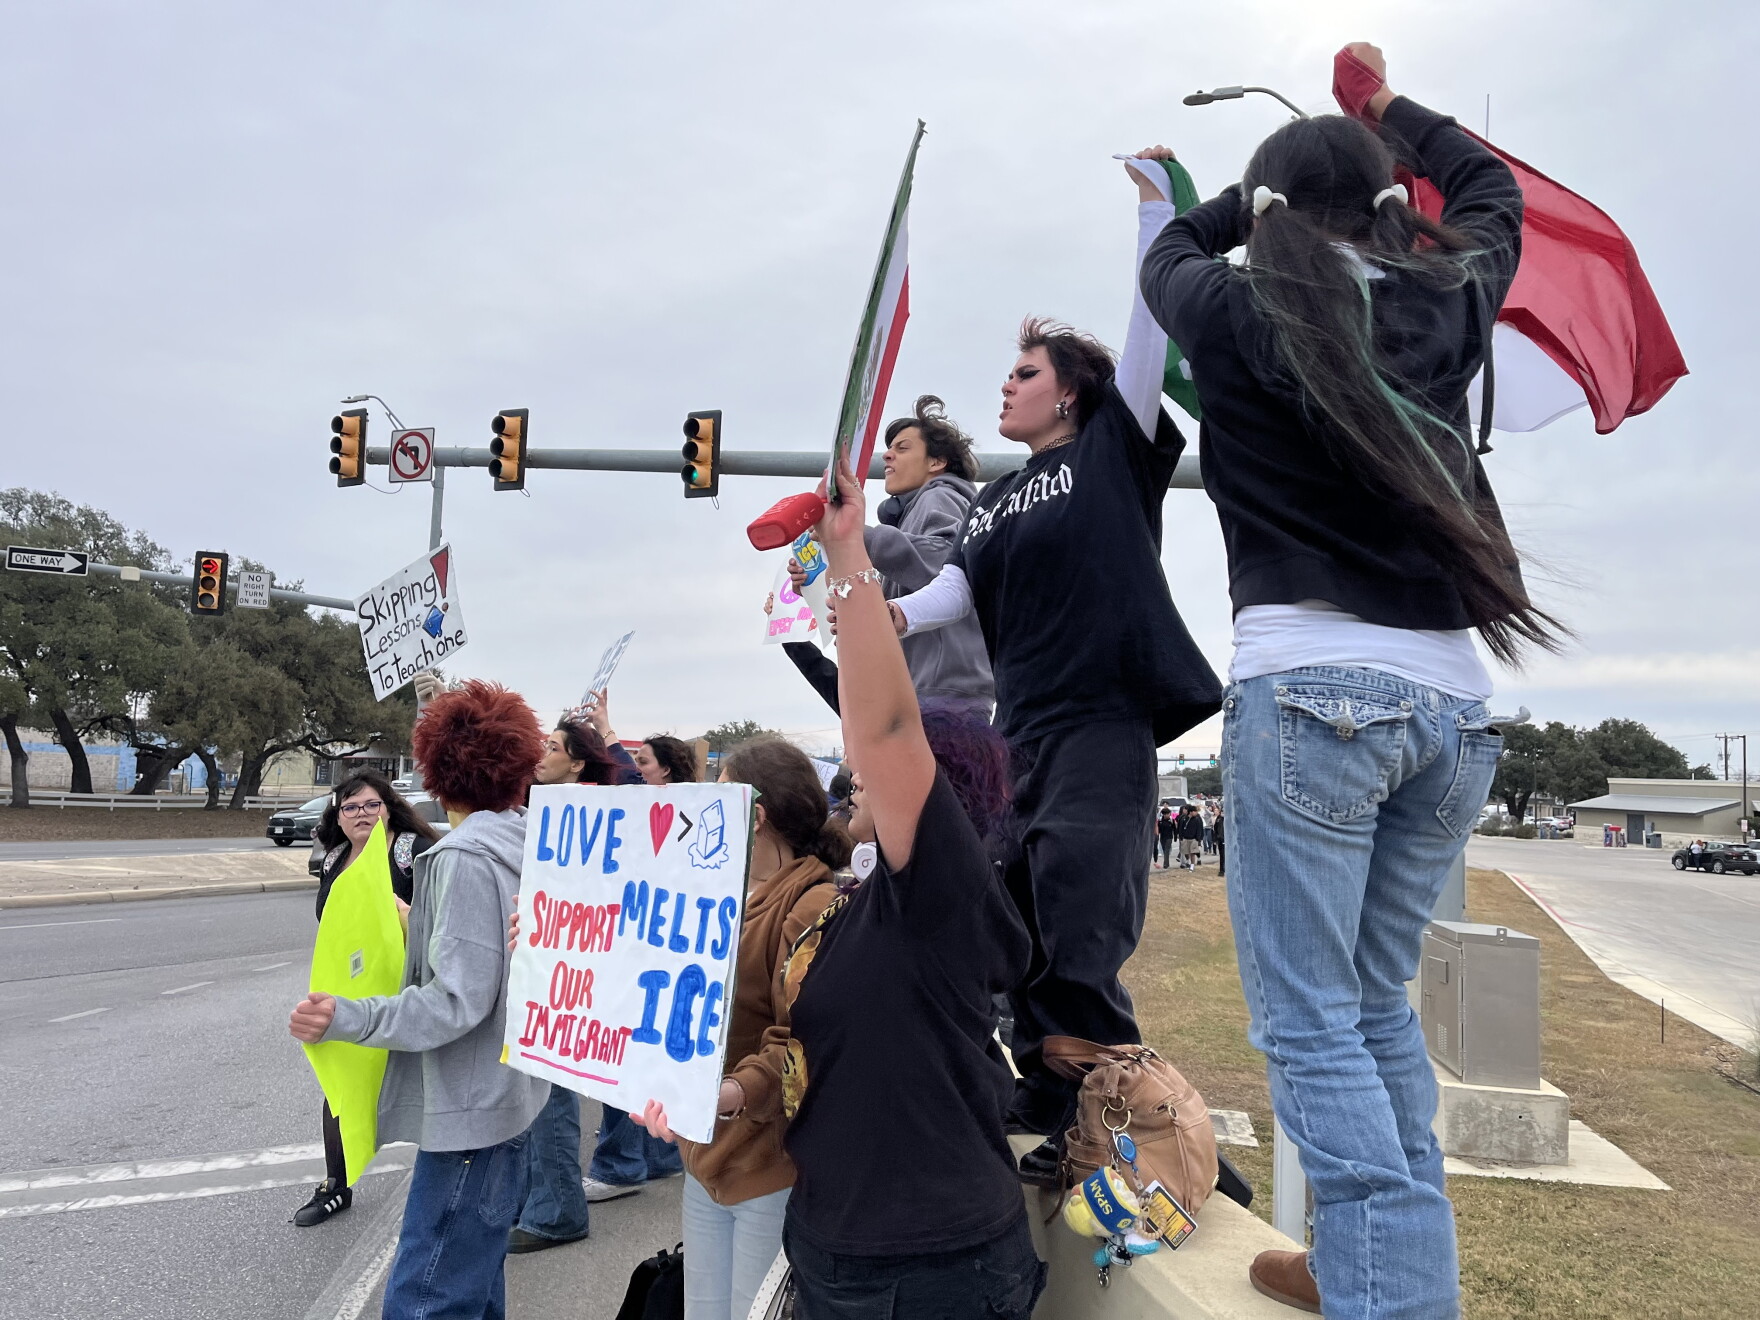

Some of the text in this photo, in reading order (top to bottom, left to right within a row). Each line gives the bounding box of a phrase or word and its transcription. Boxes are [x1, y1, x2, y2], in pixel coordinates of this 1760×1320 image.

[14, 553, 63, 566] ONE WAY
[247, 574, 262, 582] NO
[243, 582, 265, 590] RIGHT
[245, 590, 264, 598] TURN
[253, 598, 268, 606] RED
[358, 570, 437, 635] Skipping
[365, 614, 422, 659] Lessons
[372, 661, 394, 691] To
[436, 629, 466, 657] one
[537, 803, 626, 875] LOVE
[529, 890, 620, 953] SUPPORT
[618, 880, 737, 961] MELTS
[549, 961, 594, 1011] OUR
[519, 1001, 633, 1067] IMMIGRANT
[632, 963, 724, 1063] ICE
[1090, 1179, 1113, 1215] SPAM
